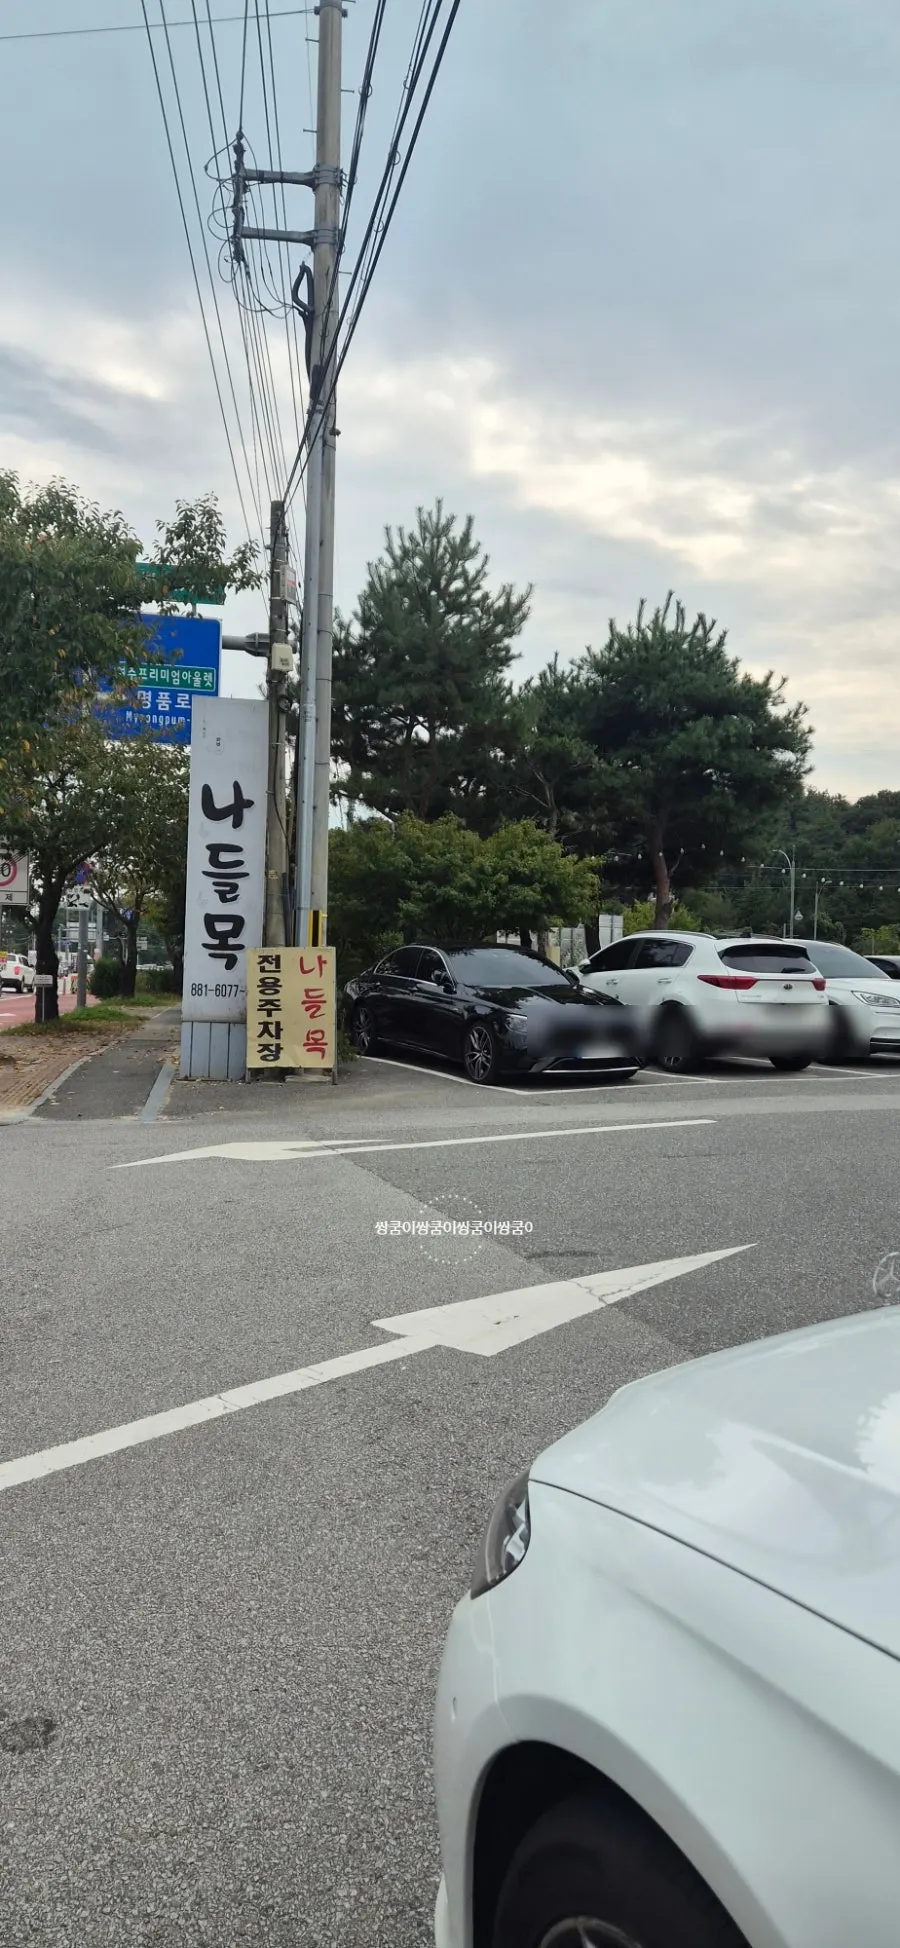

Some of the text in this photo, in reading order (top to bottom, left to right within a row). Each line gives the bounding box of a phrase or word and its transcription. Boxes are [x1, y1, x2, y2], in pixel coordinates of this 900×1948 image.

[137, 690, 192, 711] 명품로
[201, 780, 255, 971] 나들목
[257, 954, 284, 1062] 전용주차장
[299, 954, 329, 1060] 나들목
